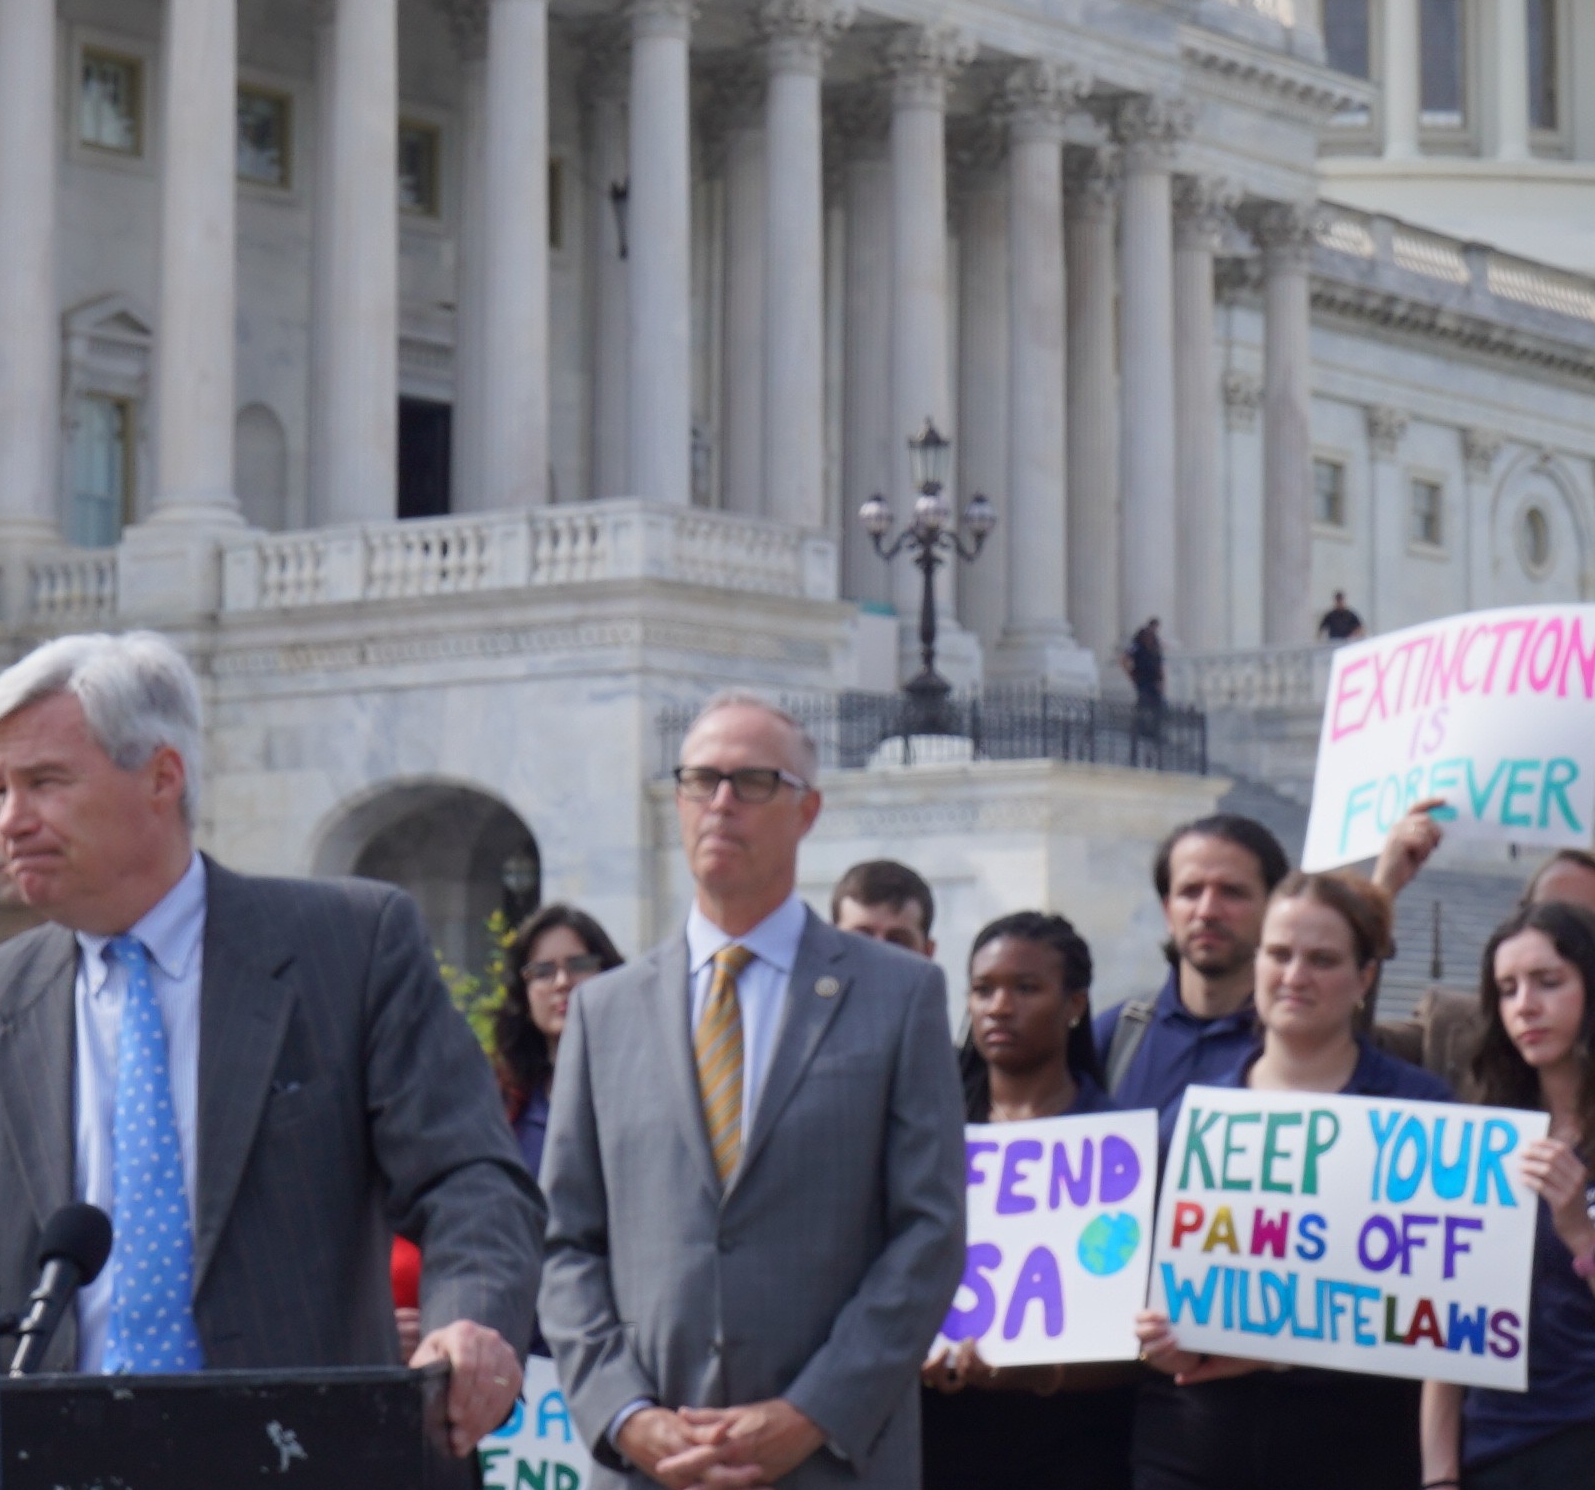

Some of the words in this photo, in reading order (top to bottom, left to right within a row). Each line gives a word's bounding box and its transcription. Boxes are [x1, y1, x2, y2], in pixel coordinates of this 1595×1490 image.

[1409, 706, 1450, 760] IS
[1338, 757, 1584, 856] FOREVER
[1178, 1107, 1340, 1195] KEEP
[1368, 1108, 1519, 1207] YOUR
[1169, 1199, 1329, 1262] PAWS
[1357, 1213, 1484, 1279] OFF
